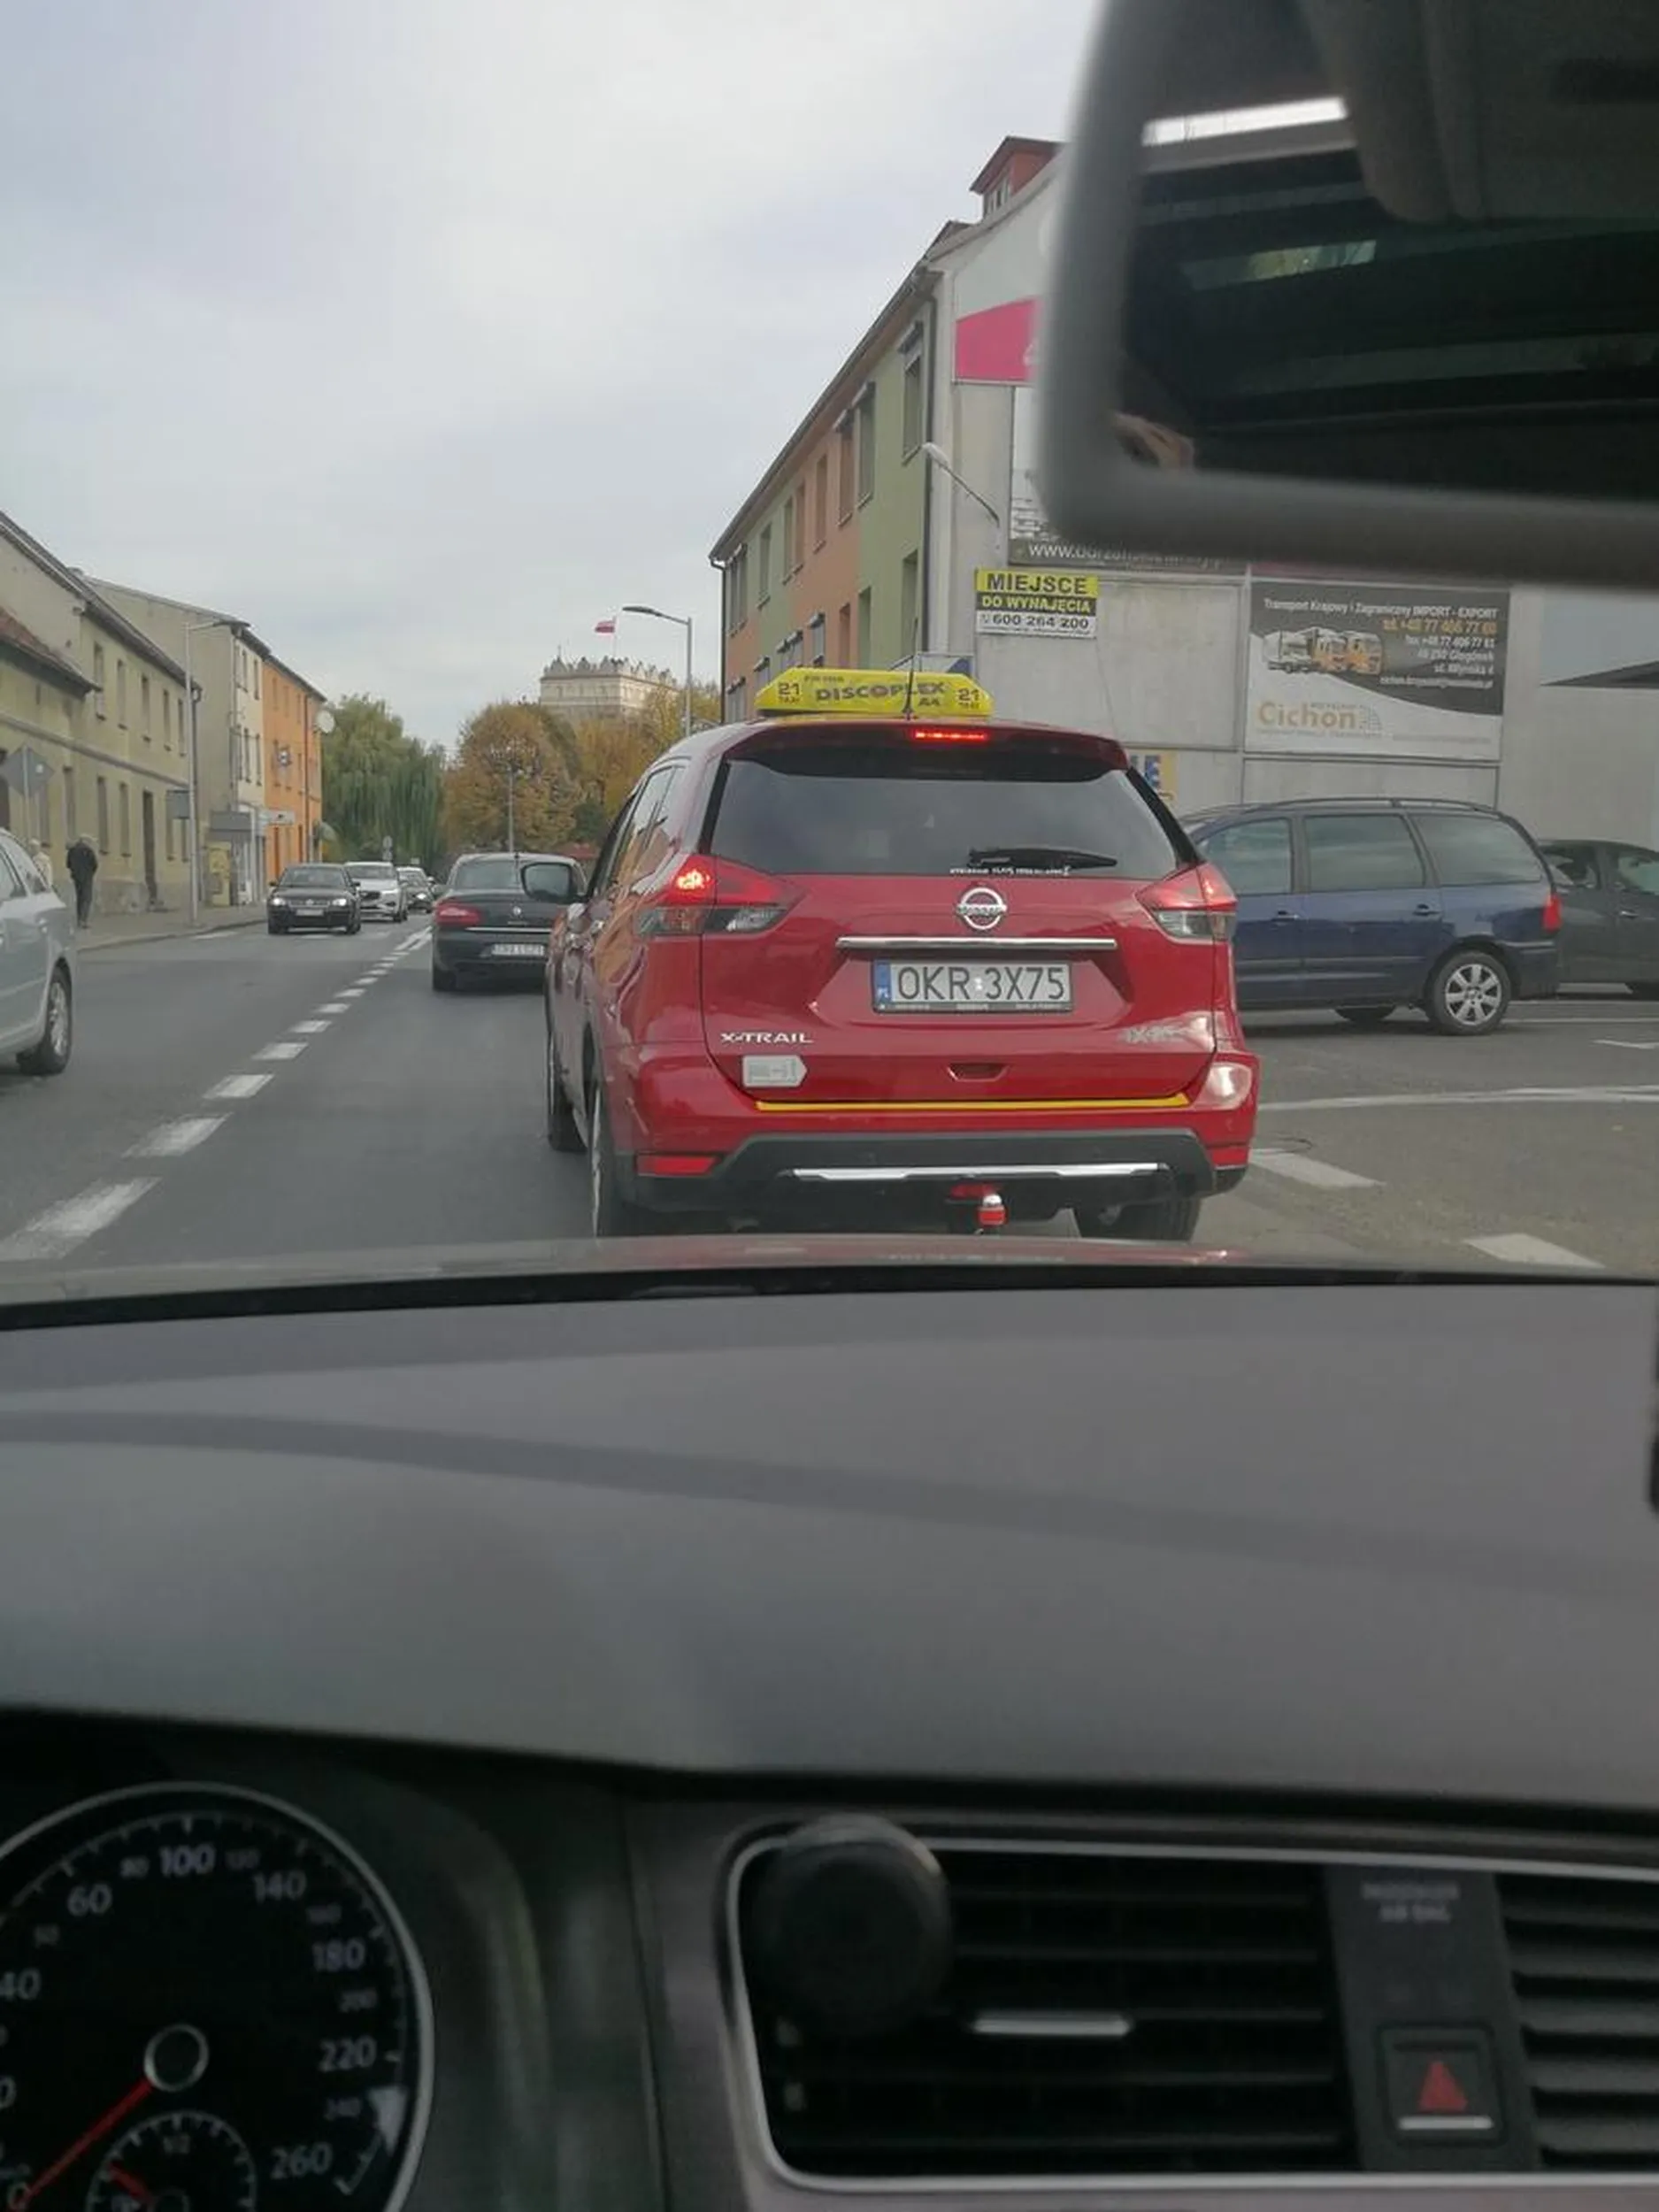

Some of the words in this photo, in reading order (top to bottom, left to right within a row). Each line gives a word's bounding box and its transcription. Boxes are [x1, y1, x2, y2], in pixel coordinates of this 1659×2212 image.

[987, 572, 1088, 595] MIEJSCE
[981, 595, 1002, 608] DO
[1007, 596, 1091, 614] WYNAJĘCIA
[992, 612, 1022, 626] 600
[1026, 614, 1056, 628] 264
[1062, 617, 1089, 631] 200
[777, 682, 801, 696] 21
[957, 687, 980, 702] 21
[1257, 701, 1357, 729] Cichon
[897, 965, 972, 1001] OKR
[984, 965, 1064, 1001] 3X75
[720, 1032, 816, 1044] X-TRAIL
[159, 1843, 216, 1877] 100
[66, 1883, 113, 1917] 60
[254, 1870, 307, 1902] 140
[312, 1938, 366, 1972] 180
[0, 1968, 42, 2000] 40
[319, 2035, 378, 2072] 220
[269, 2140, 334, 2181] 260
